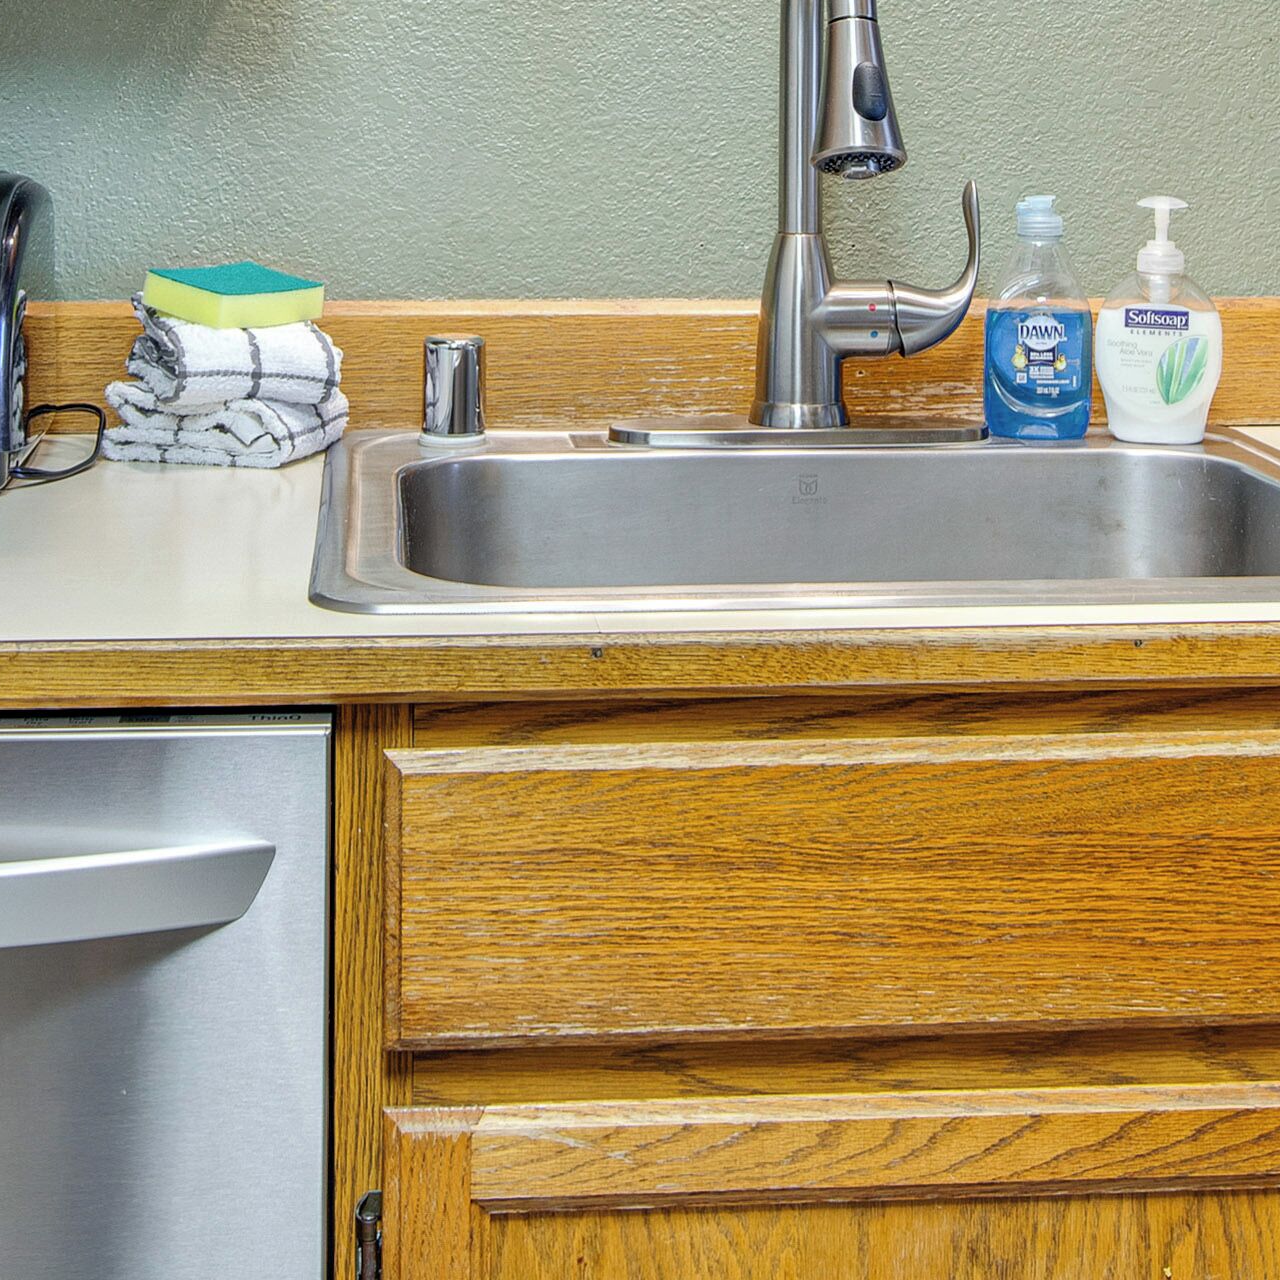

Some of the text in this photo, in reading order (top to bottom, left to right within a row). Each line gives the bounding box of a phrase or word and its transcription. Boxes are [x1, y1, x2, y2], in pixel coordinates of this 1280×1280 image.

[1128, 310, 1187, 328] Softsoap
[1020, 324, 1064, 340] DAWN
[1130, 329, 1182, 337] ELEMENTS
